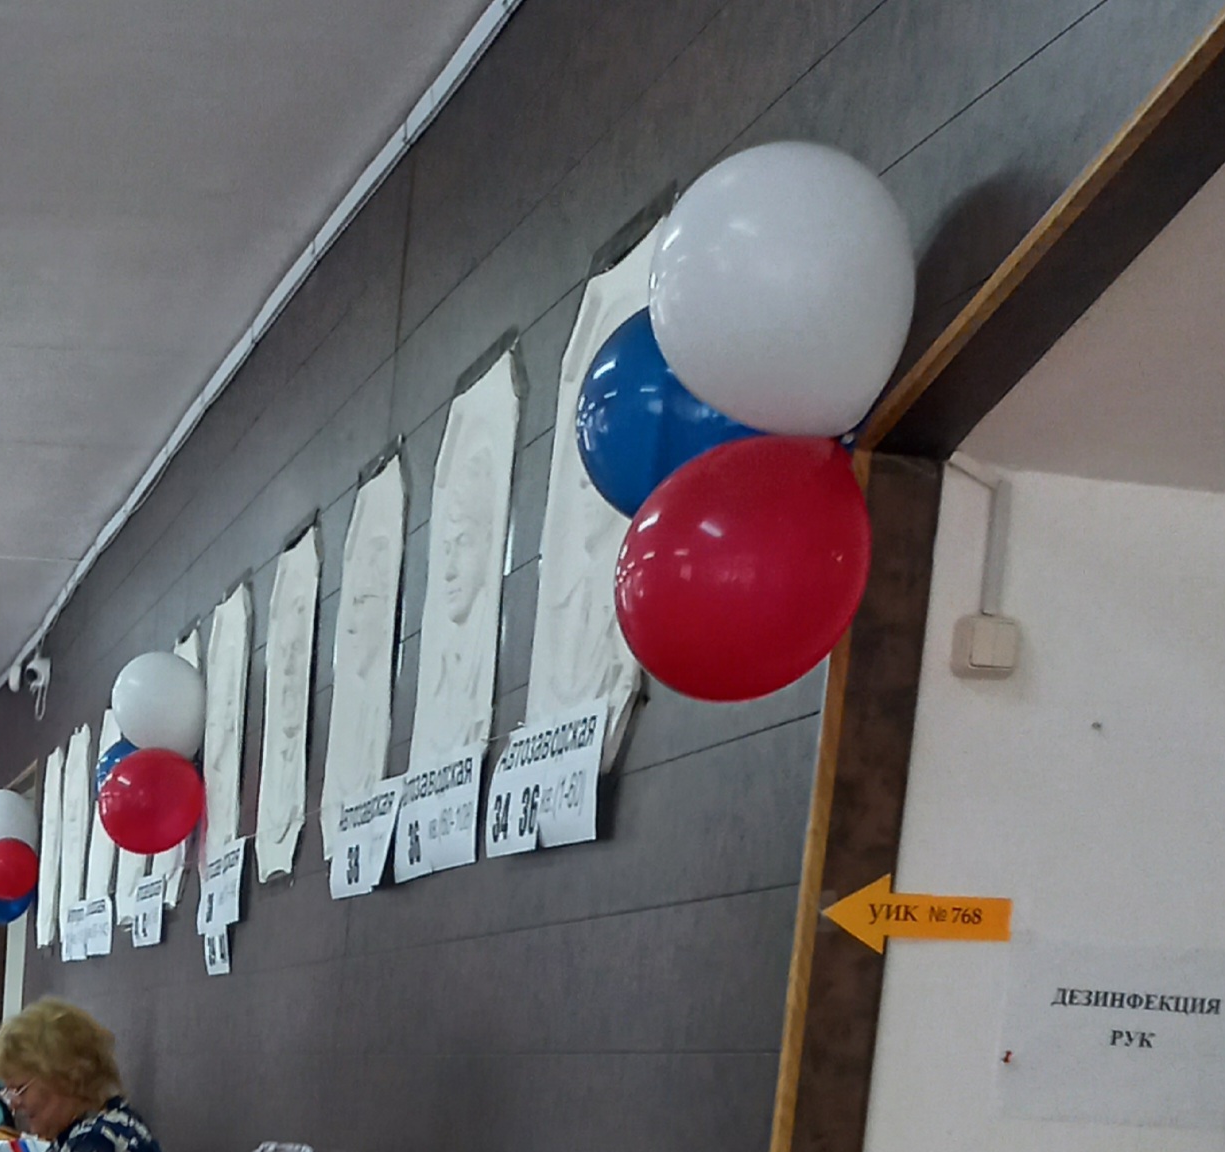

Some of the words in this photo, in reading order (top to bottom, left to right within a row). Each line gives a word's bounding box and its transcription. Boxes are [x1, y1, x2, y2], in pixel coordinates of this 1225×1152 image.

[492, 792, 511, 843] 34
[519, 784, 540, 837] 36
[869, 903, 918, 925] УИК
[929, 906, 948, 922] №
[952, 906, 983, 924] 768
[1051, 988, 1222, 1015] ДЕЗИНФЕКЦИЯ
[1110, 1029, 1157, 1048] РУК
